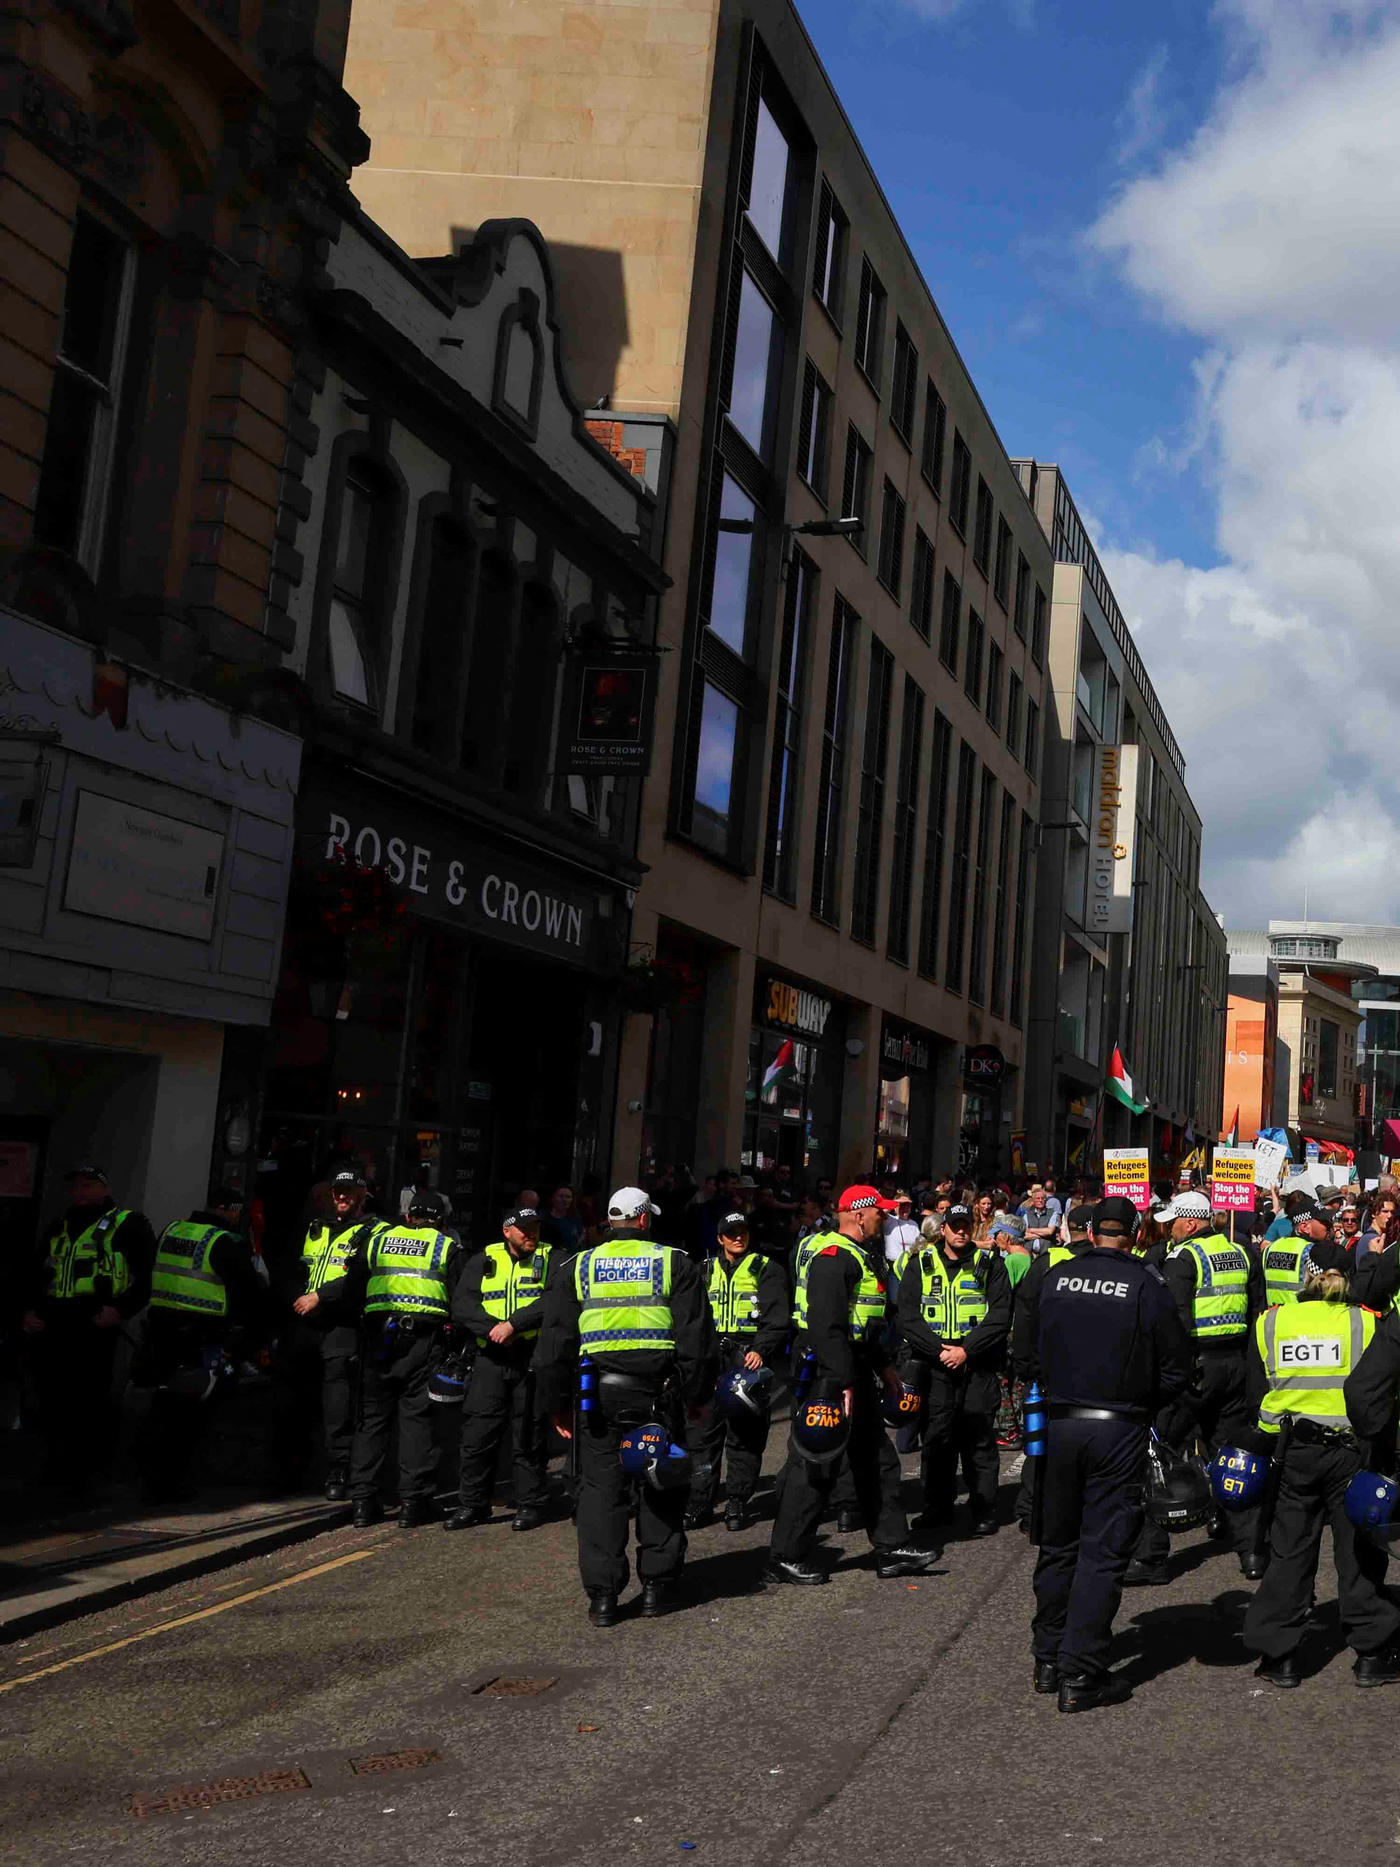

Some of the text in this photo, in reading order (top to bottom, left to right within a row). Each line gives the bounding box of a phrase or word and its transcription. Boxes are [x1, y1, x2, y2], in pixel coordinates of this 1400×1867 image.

[1097, 750, 1121, 847] maldron
[325, 812, 583, 946] ROSE & CROWN
[1094, 859, 1111, 927] HOTEL
[767, 979, 831, 1036] SUBWAY
[1107, 1161, 1147, 1171] Refugees
[1215, 1160, 1253, 1170] Refugees
[1107, 1171, 1145, 1180] welcome
[1215, 1171, 1251, 1180] welcome
[1107, 1183, 1145, 1195] Stop the
[1214, 1183, 1250, 1194] Stop the
[1214, 1193, 1249, 1206] far right
[385, 1237, 427, 1248] HEDDLU
[382, 1246, 424, 1257] POLICE
[1211, 1251, 1242, 1262] HEDDL
[598, 1269, 646, 1281] POLICE
[1056, 1277, 1129, 1298] POLICE
[1282, 1344, 1341, 1362] EGT 1
[808, 1405, 832, 1414] 1234
[805, 1413, 833, 1427] WO
[1218, 1455, 1257, 1474] 1103
[1223, 1478, 1245, 1494] LB
